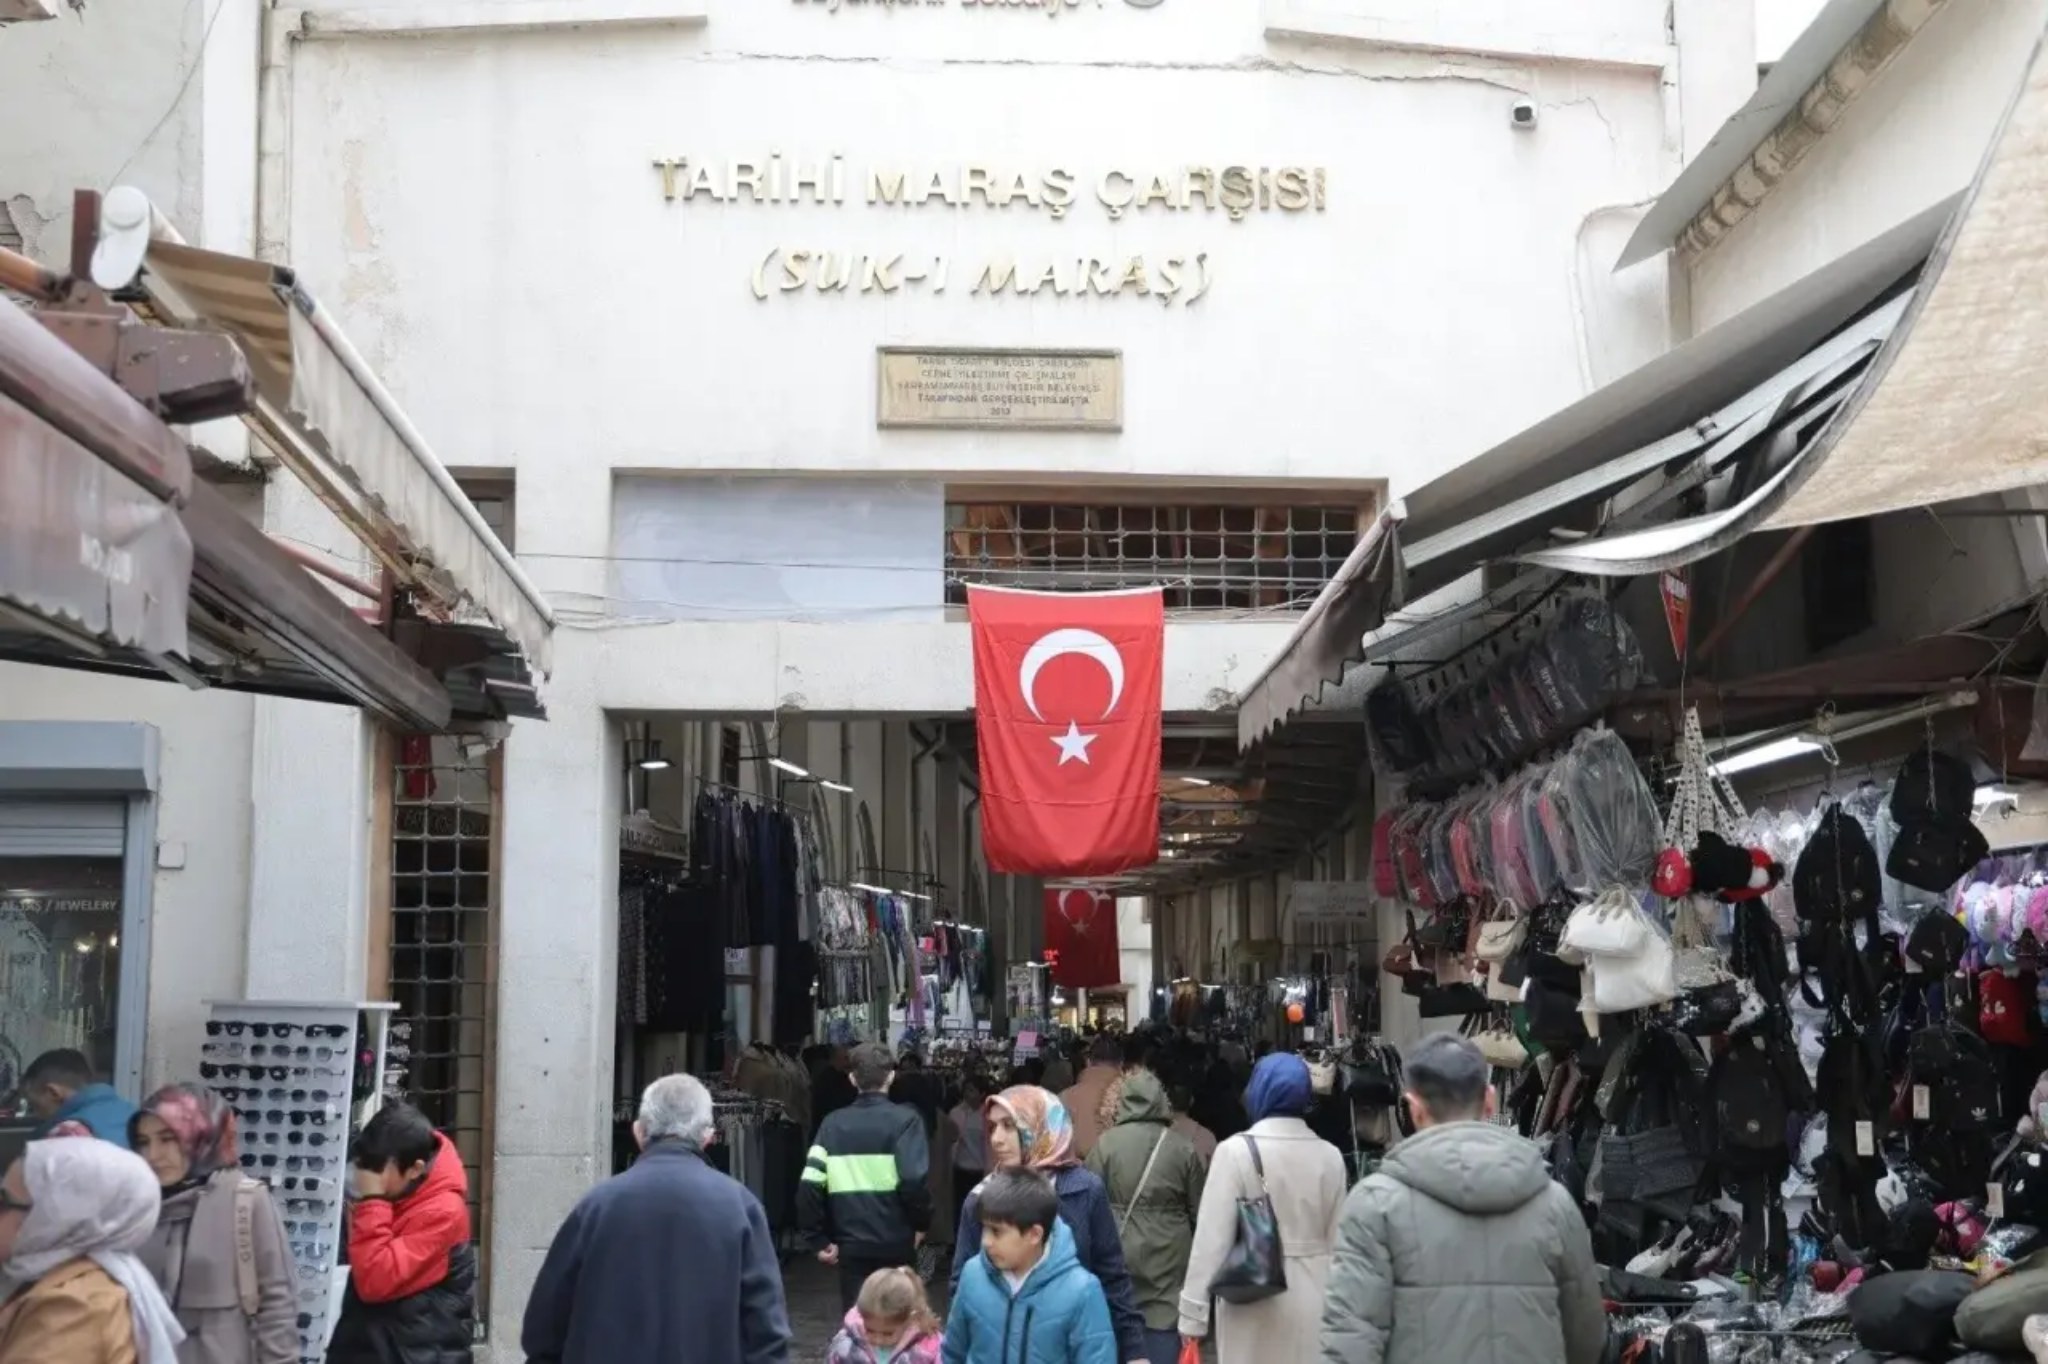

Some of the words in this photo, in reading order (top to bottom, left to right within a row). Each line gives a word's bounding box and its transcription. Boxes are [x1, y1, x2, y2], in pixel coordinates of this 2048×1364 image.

[653, 146, 844, 205] TARİHİ
[866, 163, 1077, 220] MARAŞ
[1096, 165, 1327, 222] ÇARŞISI
[969, 253, 1212, 308] MARAŞ)
[1014, 371, 1077, 383] ÇALŞMALAI
